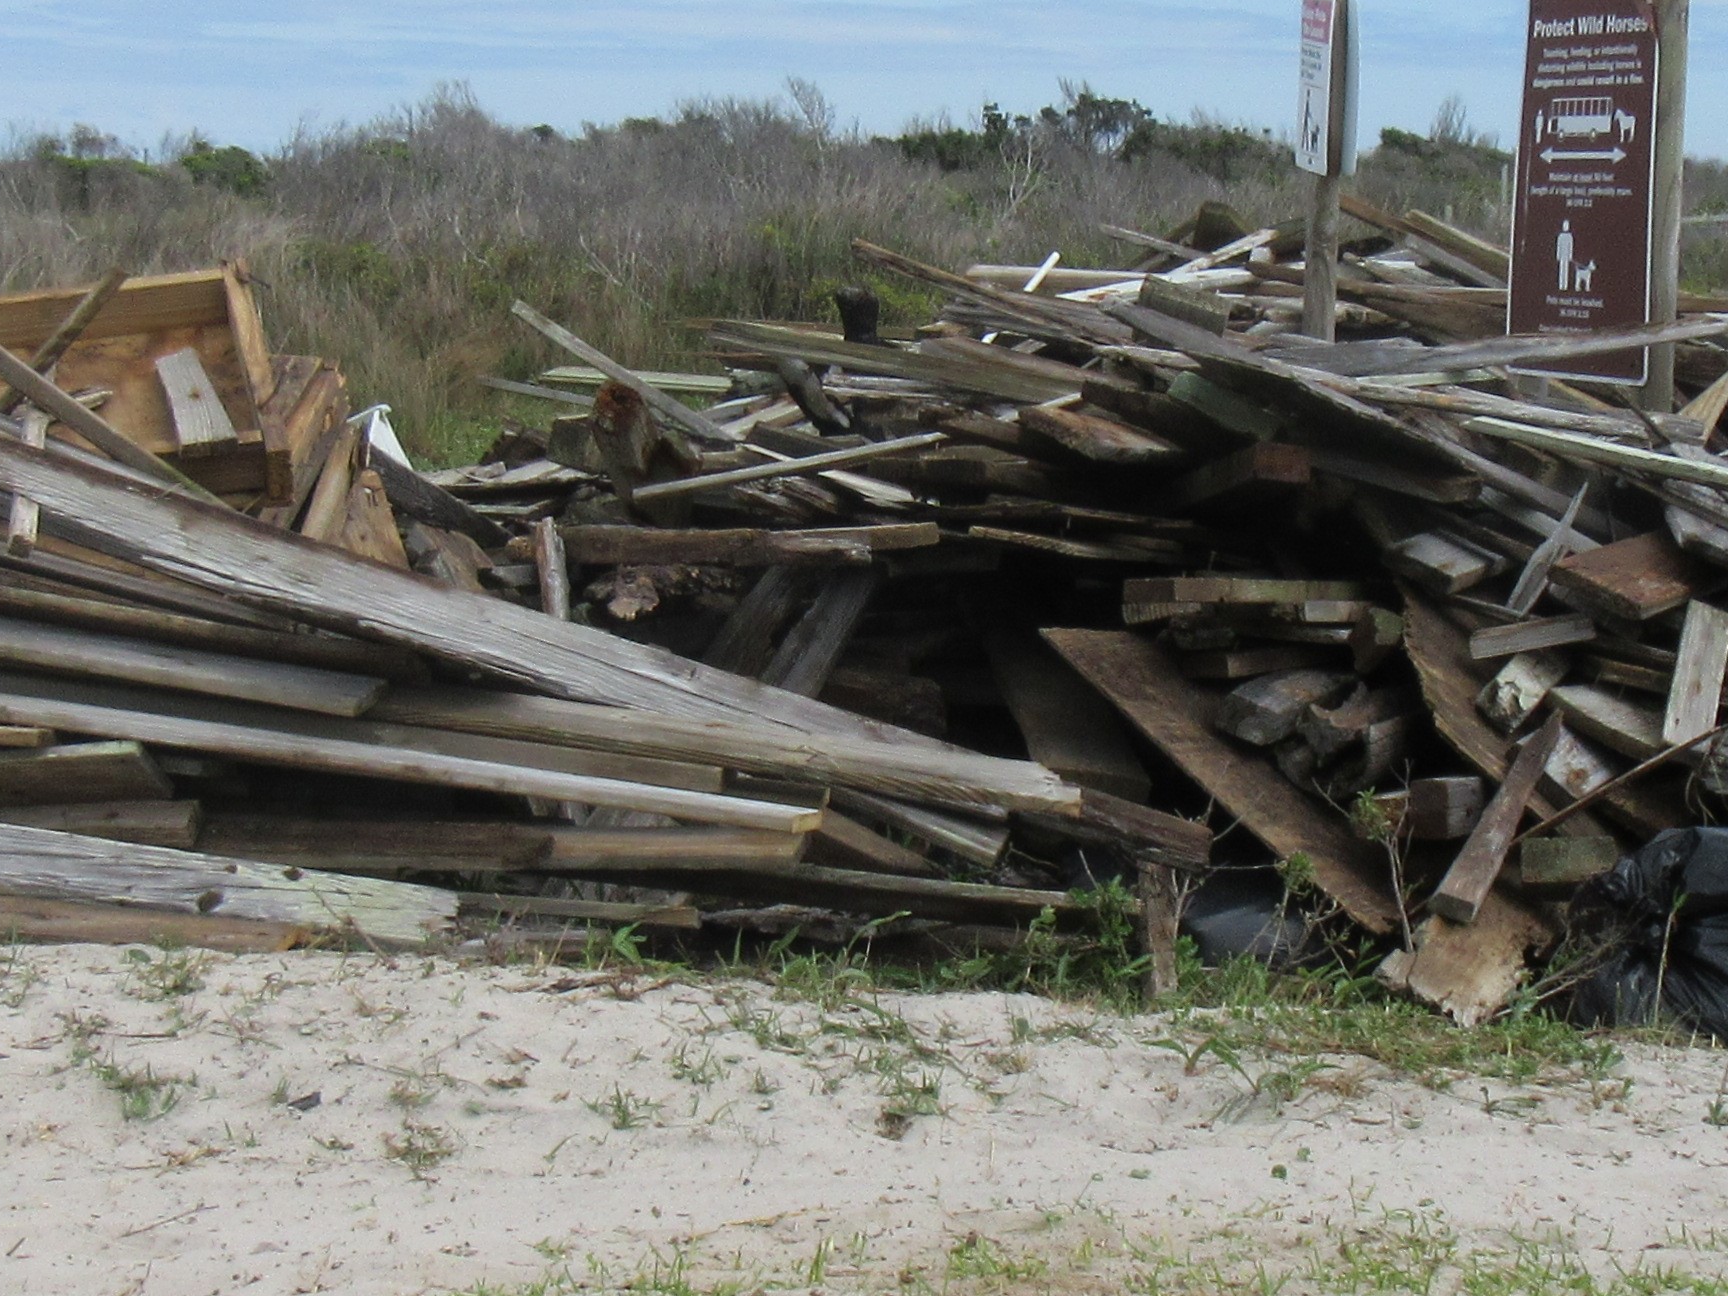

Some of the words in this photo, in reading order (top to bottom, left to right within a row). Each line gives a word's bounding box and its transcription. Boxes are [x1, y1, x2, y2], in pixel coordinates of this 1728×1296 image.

[1533, 18, 1574, 38] Protect
[1577, 14, 1604, 35] Wild
[1606, 14, 1648, 33] Horses
